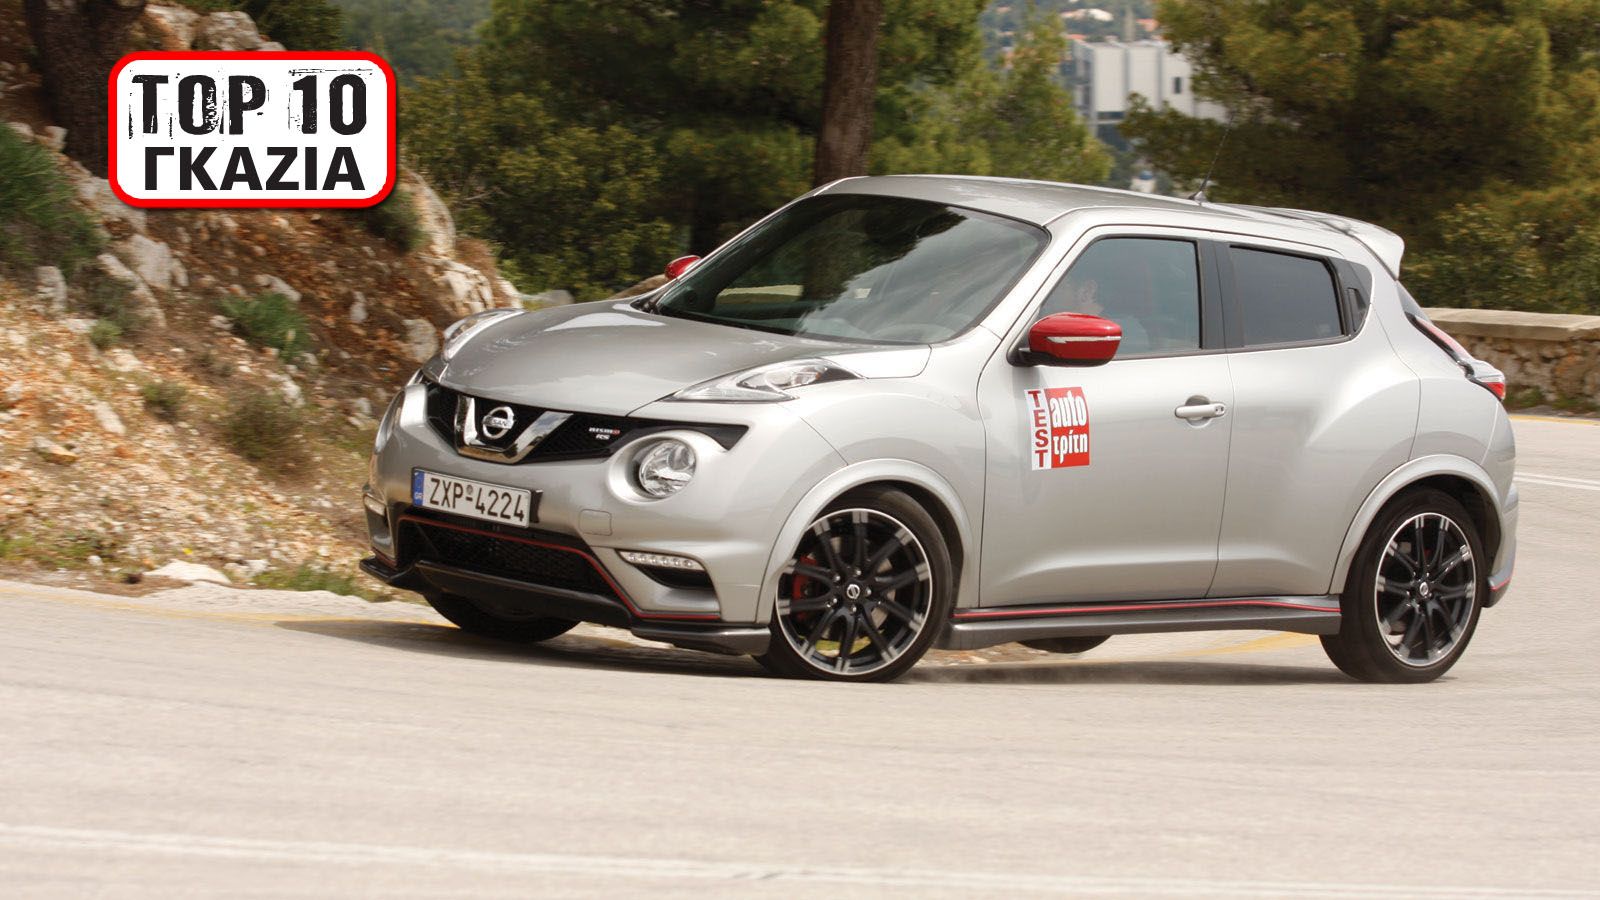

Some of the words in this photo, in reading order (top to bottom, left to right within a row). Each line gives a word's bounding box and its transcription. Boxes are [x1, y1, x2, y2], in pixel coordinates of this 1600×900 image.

[1049, 390, 1087, 428] auto
[1028, 390, 1049, 468] TEST
[1052, 429, 1088, 464] τρίτη
